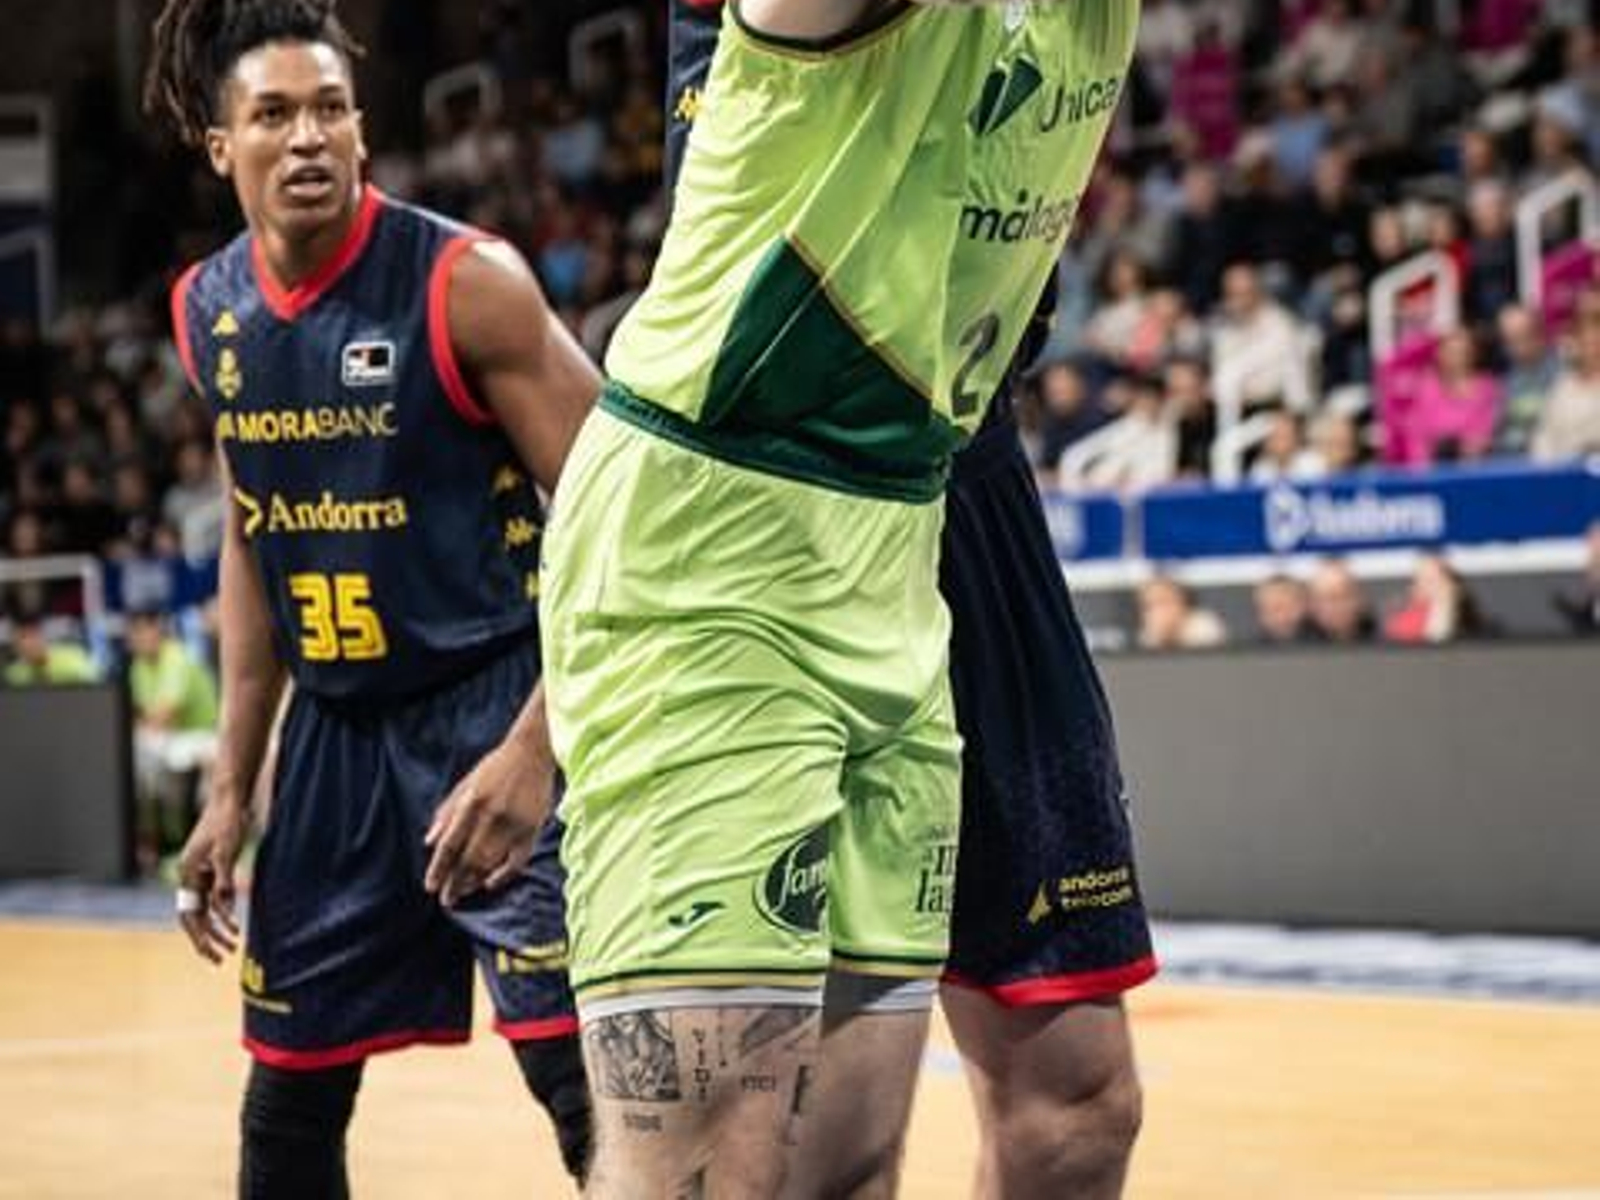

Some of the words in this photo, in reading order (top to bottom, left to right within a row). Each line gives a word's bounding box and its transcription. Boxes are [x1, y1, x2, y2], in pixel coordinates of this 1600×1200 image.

[237, 402, 398, 442] MORABANC
[268, 490, 407, 532] Andorra
[290, 574, 387, 660] 35
